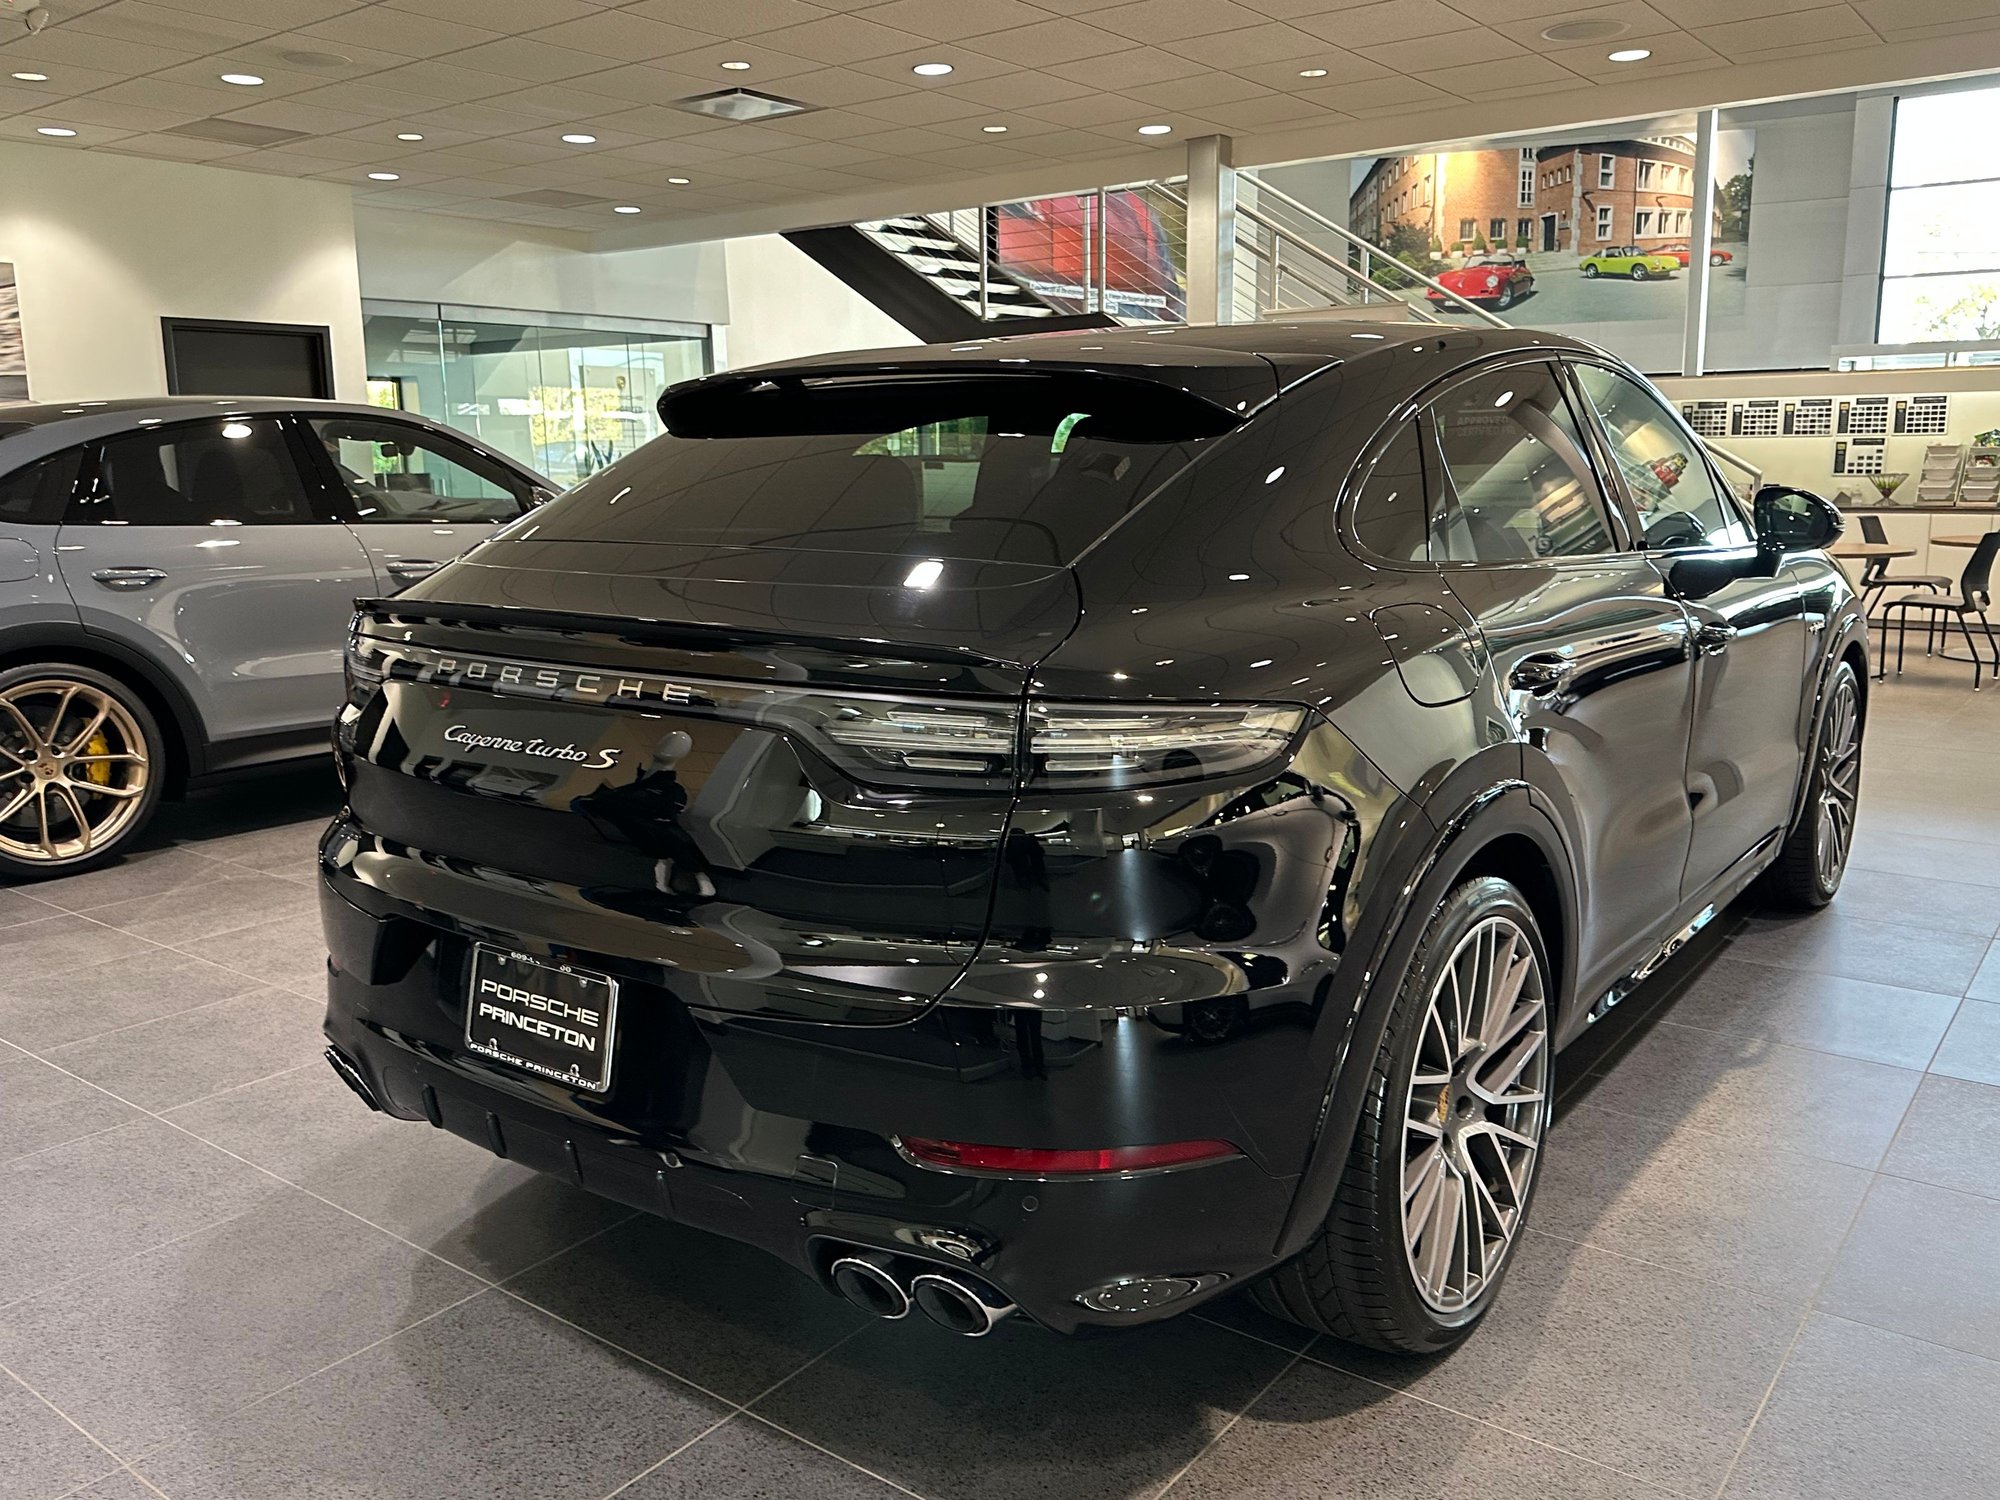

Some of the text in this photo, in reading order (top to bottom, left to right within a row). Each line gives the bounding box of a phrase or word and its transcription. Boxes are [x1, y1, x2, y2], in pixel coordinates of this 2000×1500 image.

[437, 658, 692, 704] PORSCHE
[444, 725, 622, 769] Cayenne turbo S
[479, 1002, 596, 1052] PRINCETON
[481, 979, 599, 1028] PORSCHE
[470, 1043, 597, 1090] PORSCHE PRINCETON
